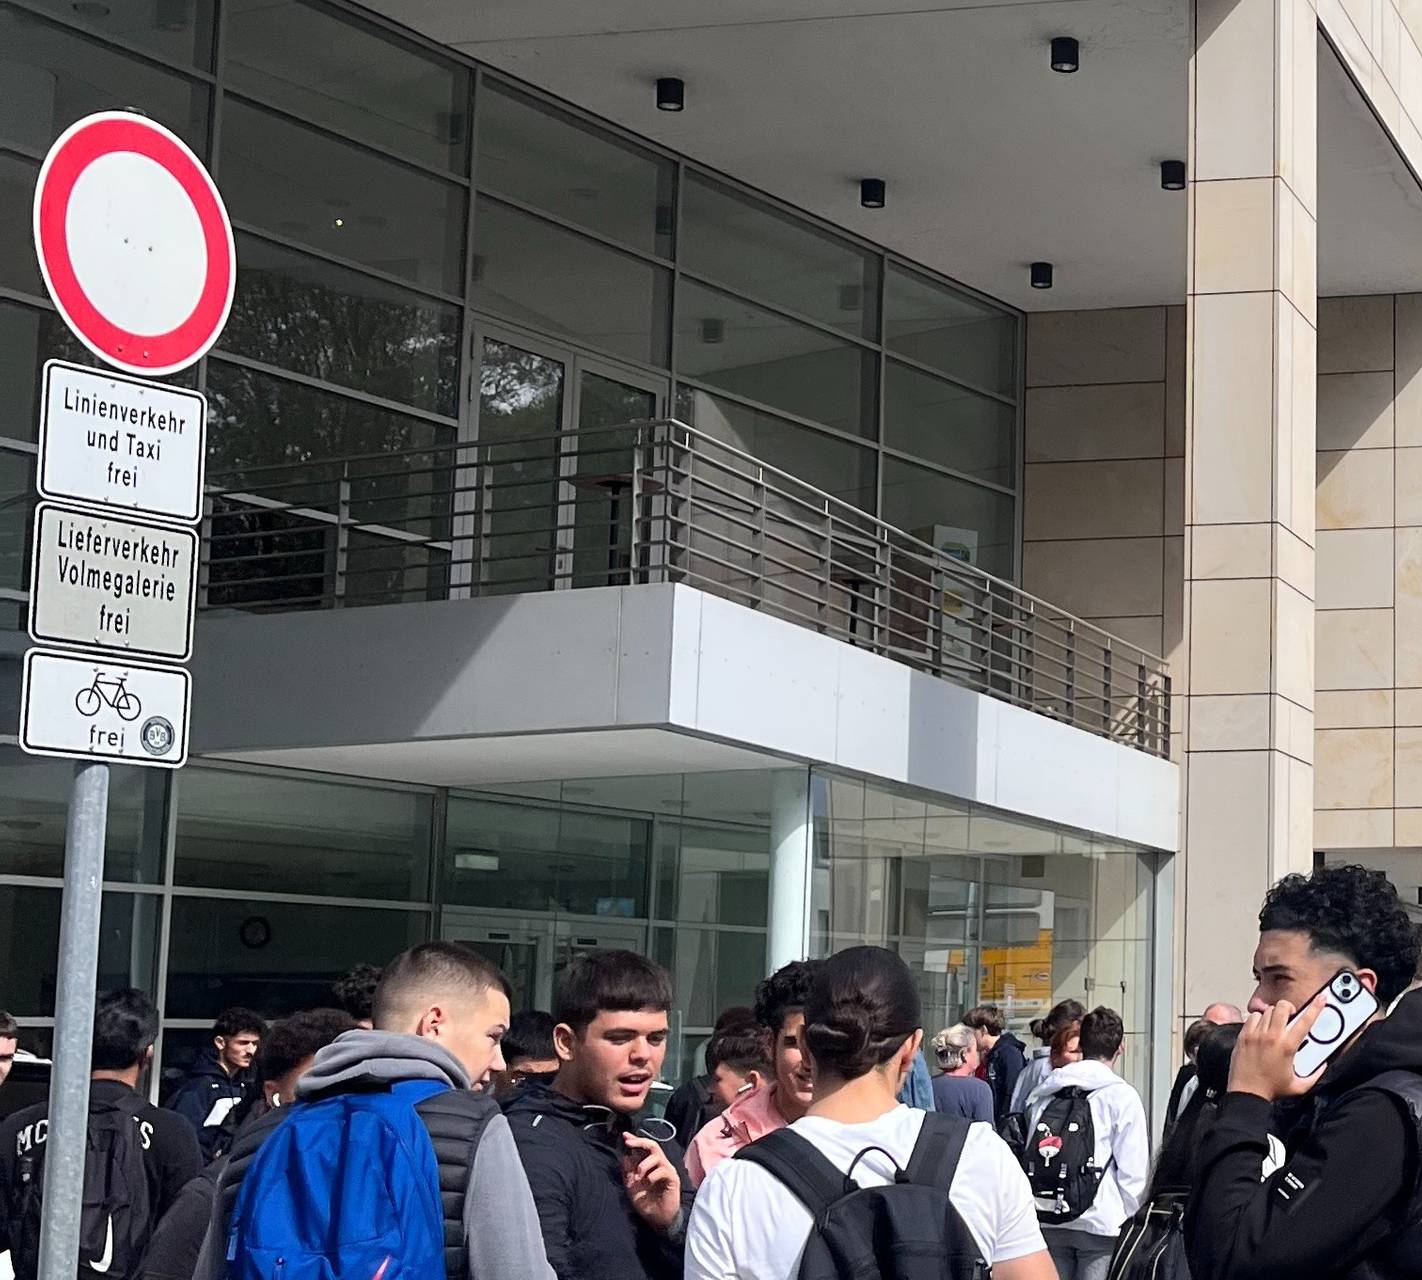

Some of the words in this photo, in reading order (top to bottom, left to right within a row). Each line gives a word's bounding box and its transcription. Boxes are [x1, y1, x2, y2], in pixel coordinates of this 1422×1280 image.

[64, 387, 186, 434] Linienverkehr
[87, 430, 119, 451] und
[127, 433, 161, 461] Taxi
[107, 461, 138, 488] frei
[57, 520, 179, 568] Lieferverkehr
[58, 555, 176, 601] Volmegalerie
[100, 604, 130, 634] frei
[90, 724, 125, 747] frei
